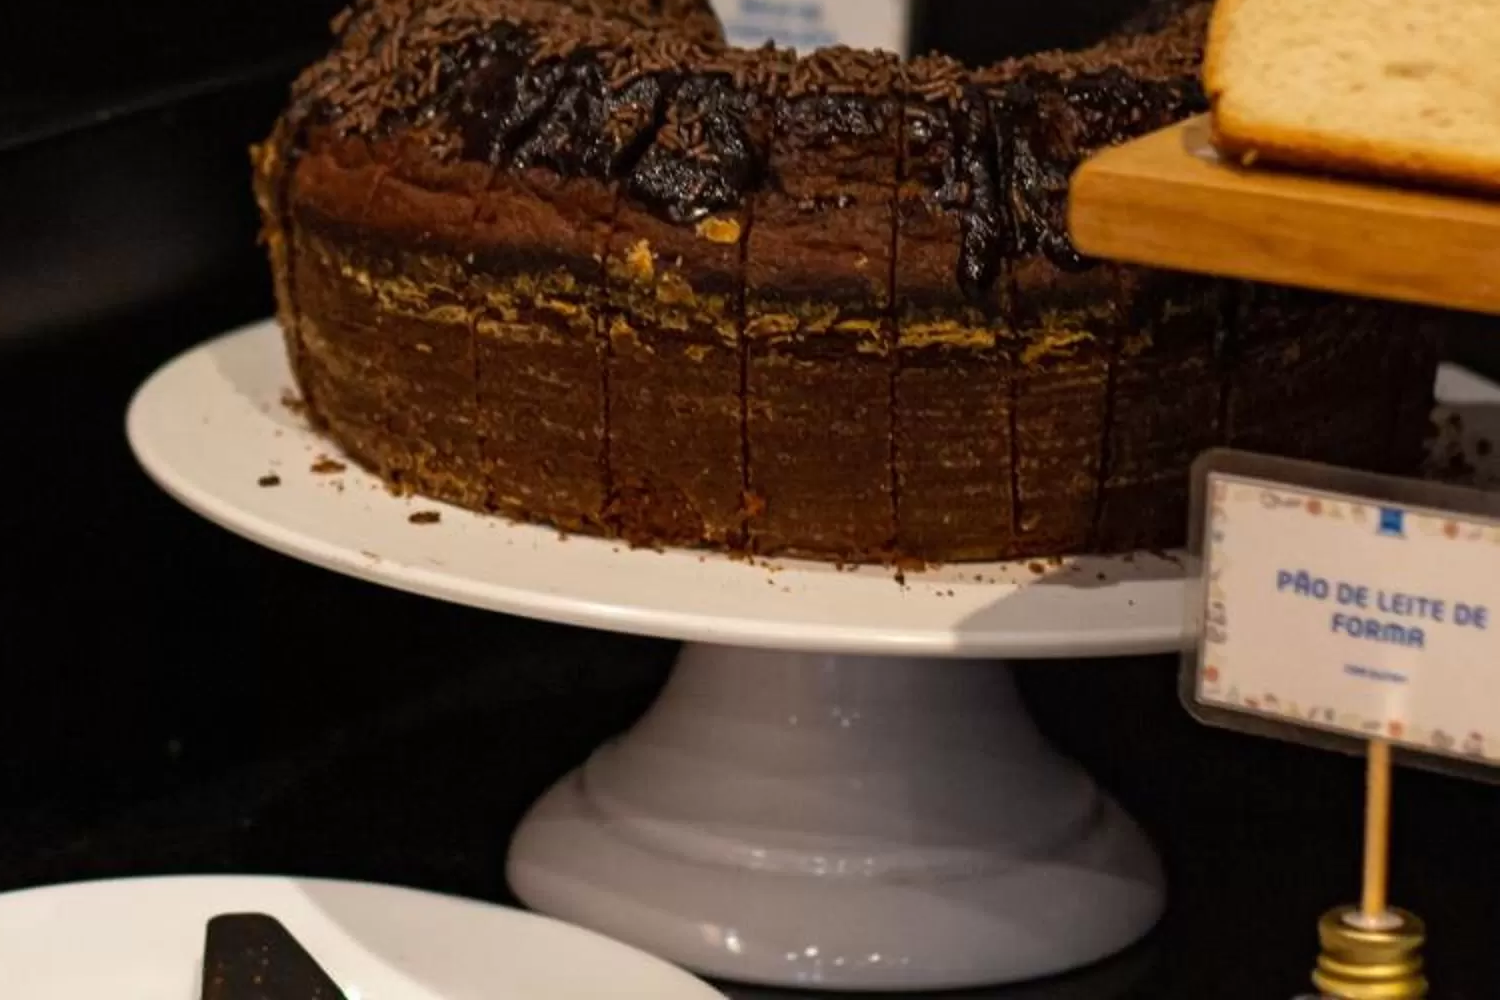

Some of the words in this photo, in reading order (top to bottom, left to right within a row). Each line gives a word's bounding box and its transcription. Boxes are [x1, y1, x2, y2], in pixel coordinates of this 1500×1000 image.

[1276, 569, 1329, 599] PÃO
[1336, 582, 1368, 609] DE
[1376, 590, 1445, 622] LEITE
[1454, 602, 1488, 630] DE
[1331, 612, 1425, 647] FORMA
